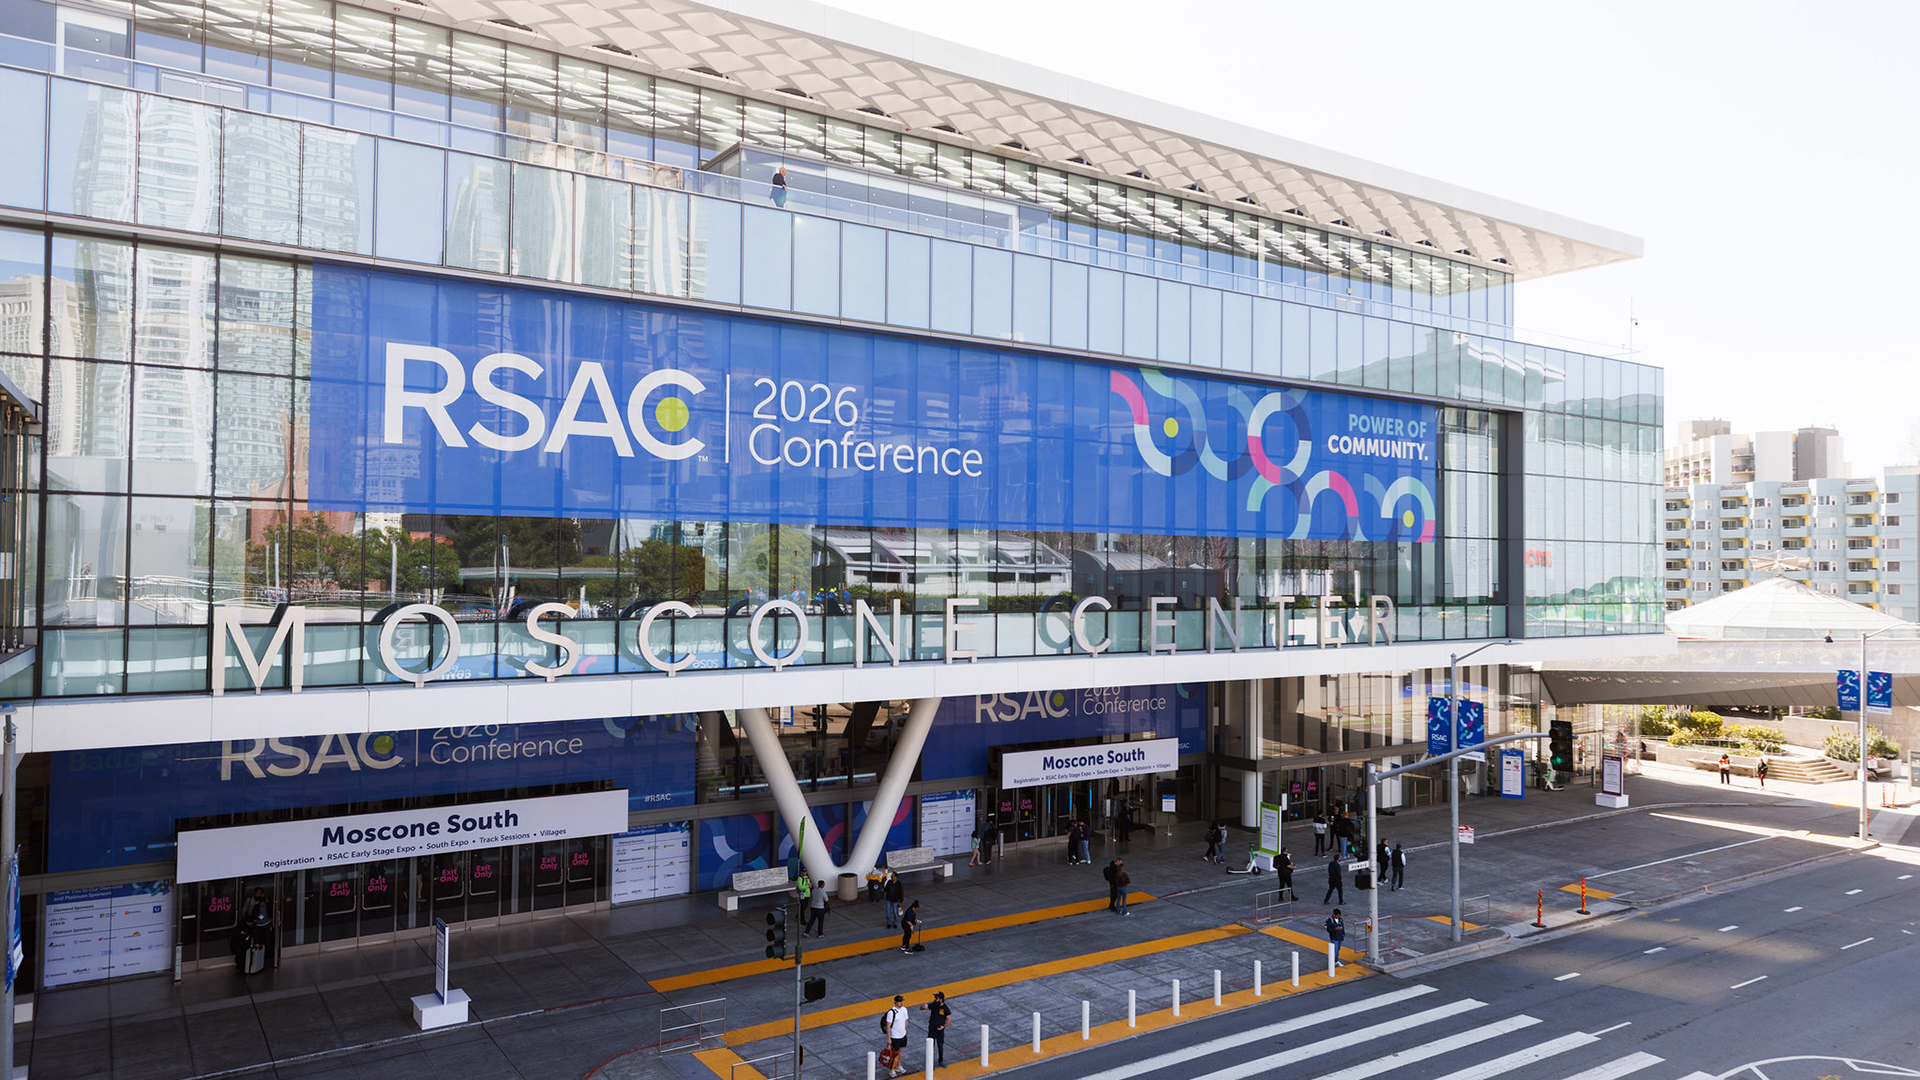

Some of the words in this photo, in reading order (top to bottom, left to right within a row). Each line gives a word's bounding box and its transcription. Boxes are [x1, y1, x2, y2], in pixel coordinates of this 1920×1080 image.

[383, 342, 707, 461] RSAC
[752, 377, 859, 428] 2026
[1348, 413, 1404, 437] POWER
[1407, 420, 1427, 439] OF
[748, 423, 984, 477] Conference
[1327, 434, 1429, 461] COMMUNITY.
[211, 597, 979, 696] MOSCONE
[1069, 594, 1395, 658] CENTER
[975, 689, 1070, 724] RSAC
[1082, 697, 1167, 716] Conference
[220, 732, 404, 782] RSAC
[430, 737, 583, 765] Conference
[1042, 754, 1104, 771] Moscone
[1107, 747, 1145, 764] South
[644, 793, 672, 804] #RSAC
[321, 820, 441, 848] Moscone
[446, 809, 519, 834] South
[263, 856, 315, 869] Registration
[327, 852, 350, 862] RSAC
[351, 849, 371, 860] Early
[372, 847, 395, 858] Stage
[396, 844, 416, 855] Expo
[426, 841, 449, 850] South
[450, 839, 469, 850] Expo
[479, 835, 499, 844] Track
[500, 832, 531, 842] Sessions
[540, 828, 567, 838] Villages
[330, 888, 350, 897] Only
[368, 884, 388, 892] Only
[370, 876, 386, 885] Exit
[209, 903, 232, 912] Only
[211, 896, 230, 904] Exit
